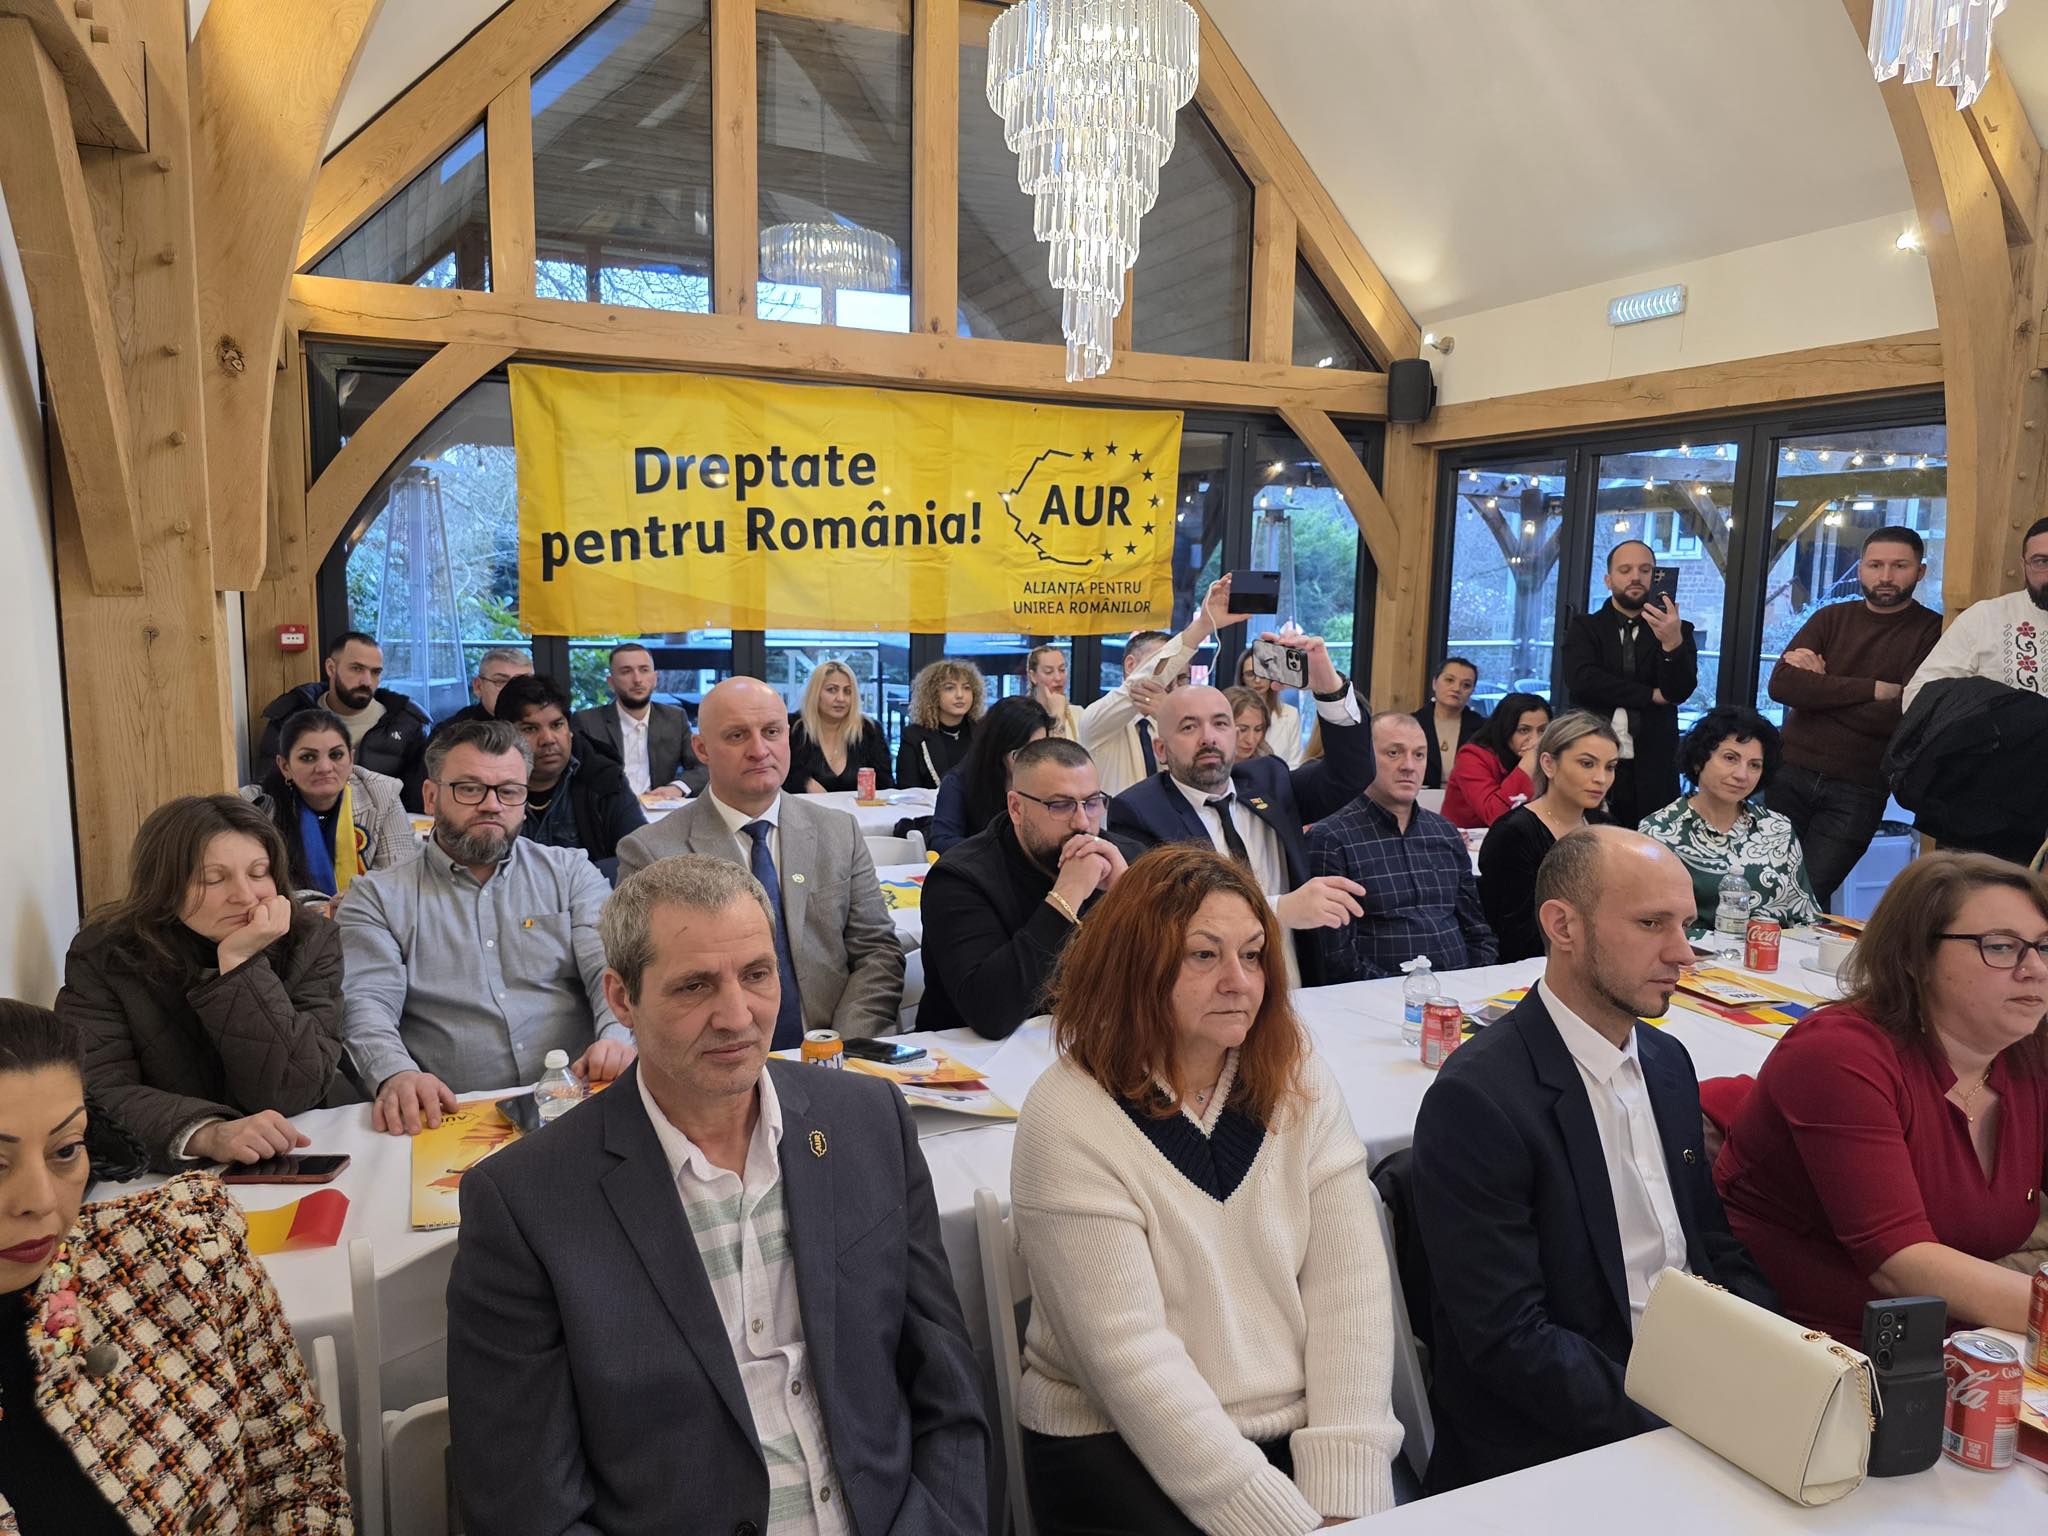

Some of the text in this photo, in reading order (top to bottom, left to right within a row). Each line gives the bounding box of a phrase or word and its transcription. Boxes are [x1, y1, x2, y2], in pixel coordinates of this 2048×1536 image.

[635, 446, 876, 501] Dreptate
[1039, 484, 1132, 526] AUR
[541, 500, 981, 582] pentru România!
[1013, 598, 1152, 614] UNIREA ROMÂNILOR
[1090, 581, 1141, 595] PENTRU
